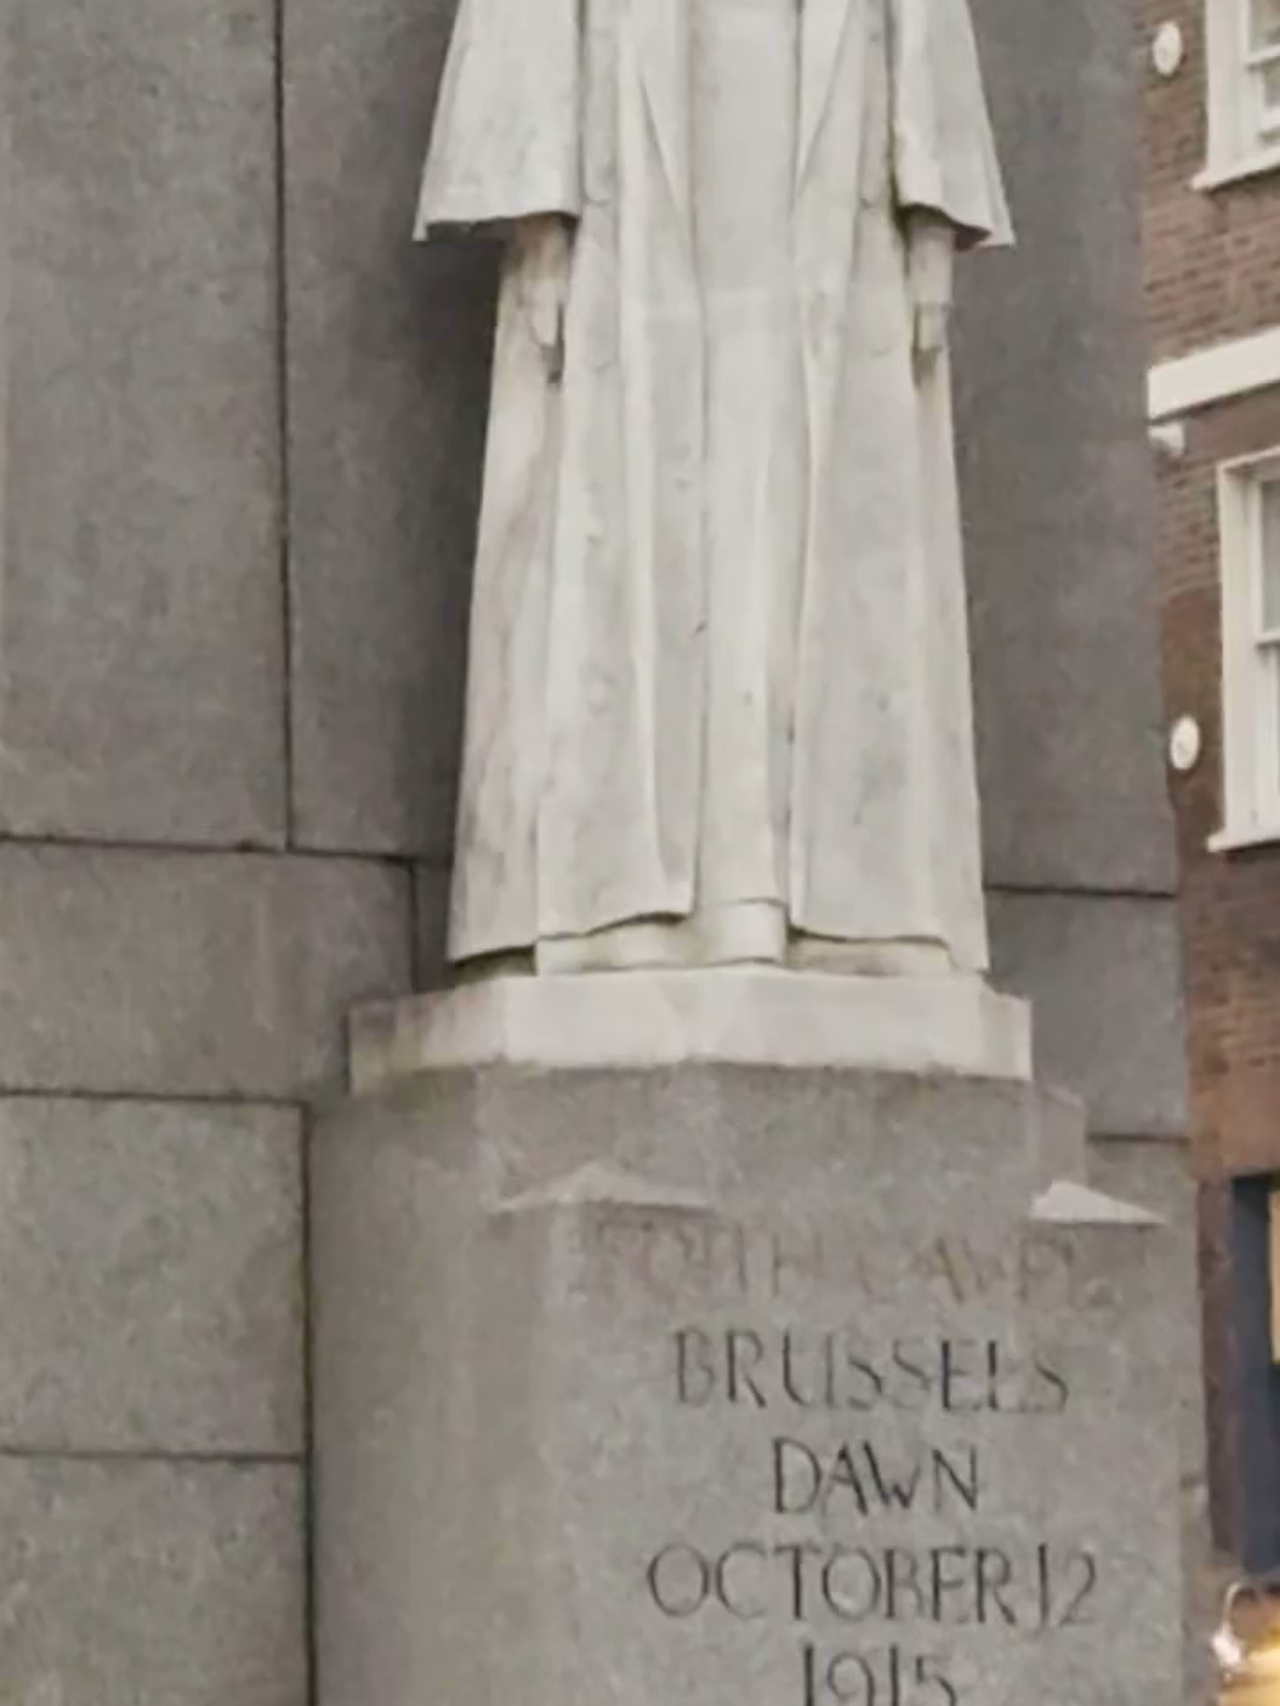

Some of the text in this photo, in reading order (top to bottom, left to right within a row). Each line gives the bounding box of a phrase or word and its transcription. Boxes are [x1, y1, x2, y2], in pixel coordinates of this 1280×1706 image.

[674, 1327, 1069, 1414] BRUSSELS
[772, 1436, 978, 1516] DAWN
[646, 1541, 1098, 1632] OCTOBER 12
